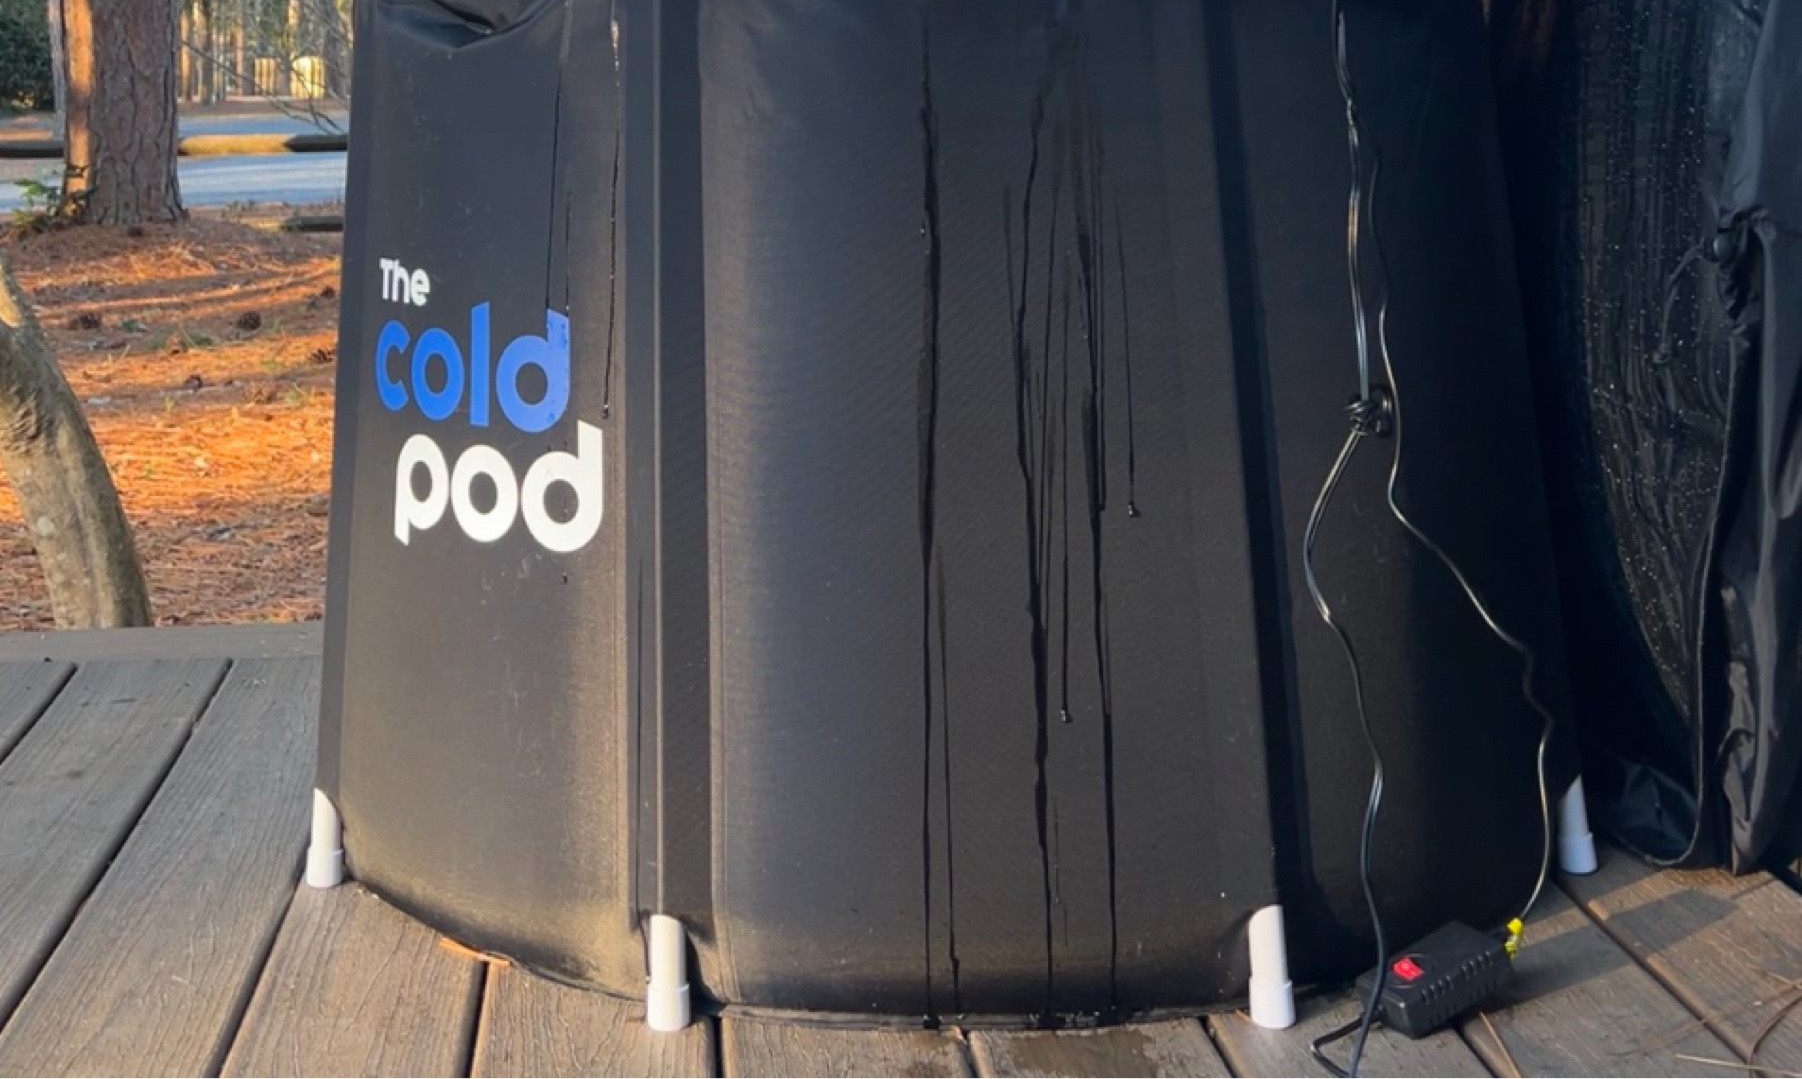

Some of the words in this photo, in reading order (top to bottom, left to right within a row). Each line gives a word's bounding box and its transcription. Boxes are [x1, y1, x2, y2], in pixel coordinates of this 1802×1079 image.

[379, 258, 430, 306] The
[374, 301, 571, 432] cold
[394, 419, 604, 553] pod
